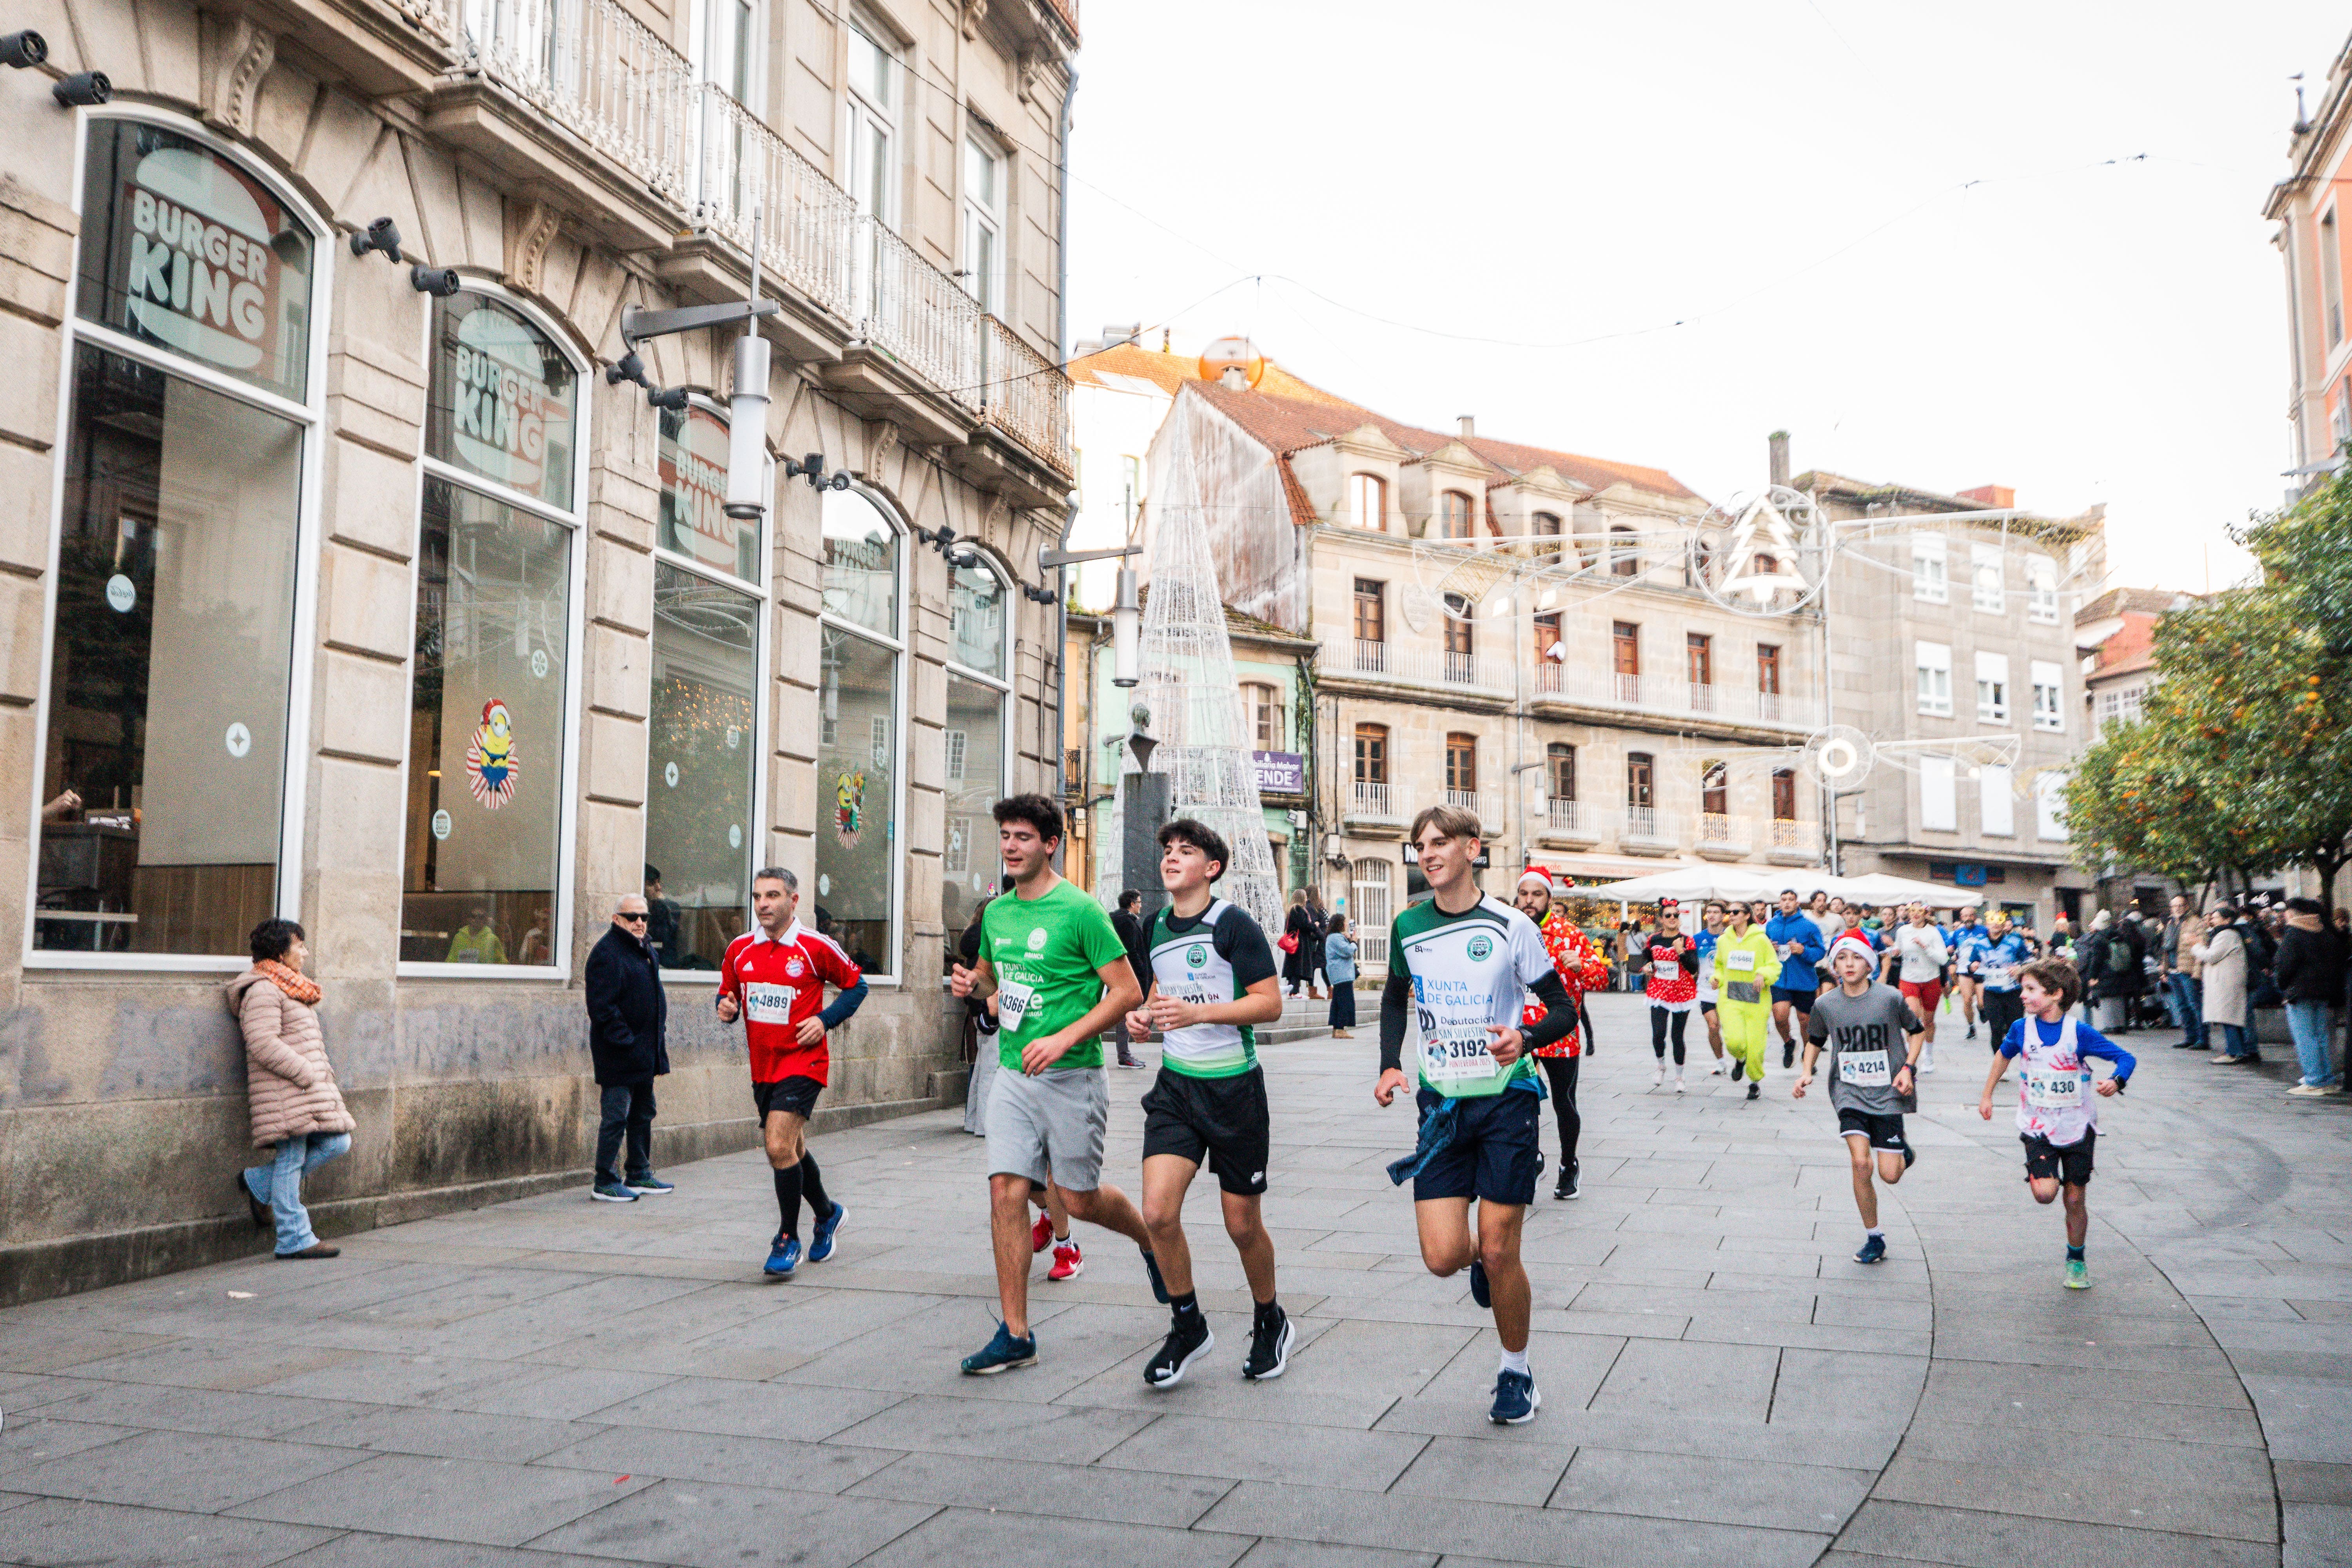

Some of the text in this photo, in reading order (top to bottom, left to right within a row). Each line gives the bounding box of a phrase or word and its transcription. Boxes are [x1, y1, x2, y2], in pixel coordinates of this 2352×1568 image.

[133, 189, 268, 287] BURGER
[130, 232, 265, 339] KING
[456, 345, 544, 416] BURGER
[454, 380, 544, 459] KING
[675, 479, 736, 544] KING
[1253, 759, 1299, 769] biliaria Malvar
[1255, 769, 1292, 785] ENDE
[1004, 963, 1027, 971] XUNTA
[1014, 972, 1044, 984] GALICIA
[1427, 979, 1468, 991] XUNTA
[759, 994, 788, 1008] 4889
[1207, 992, 1219, 1000] ÓN
[1427, 993, 1493, 1005] DE GALICIA
[1003, 994, 1025, 1013] 4366
[1441, 1014, 1494, 1025] Deputación
[1439, 1029, 1452, 1039] SAN
[1454, 1027, 1486, 1038] SILVESTRE
[1449, 1039, 1488, 1058] 3192
[1449, 1059, 1478, 1067] PONTEVEDRA
[1858, 1060, 1885, 1073] 4214
[2051, 1080, 2074, 1093] 430
